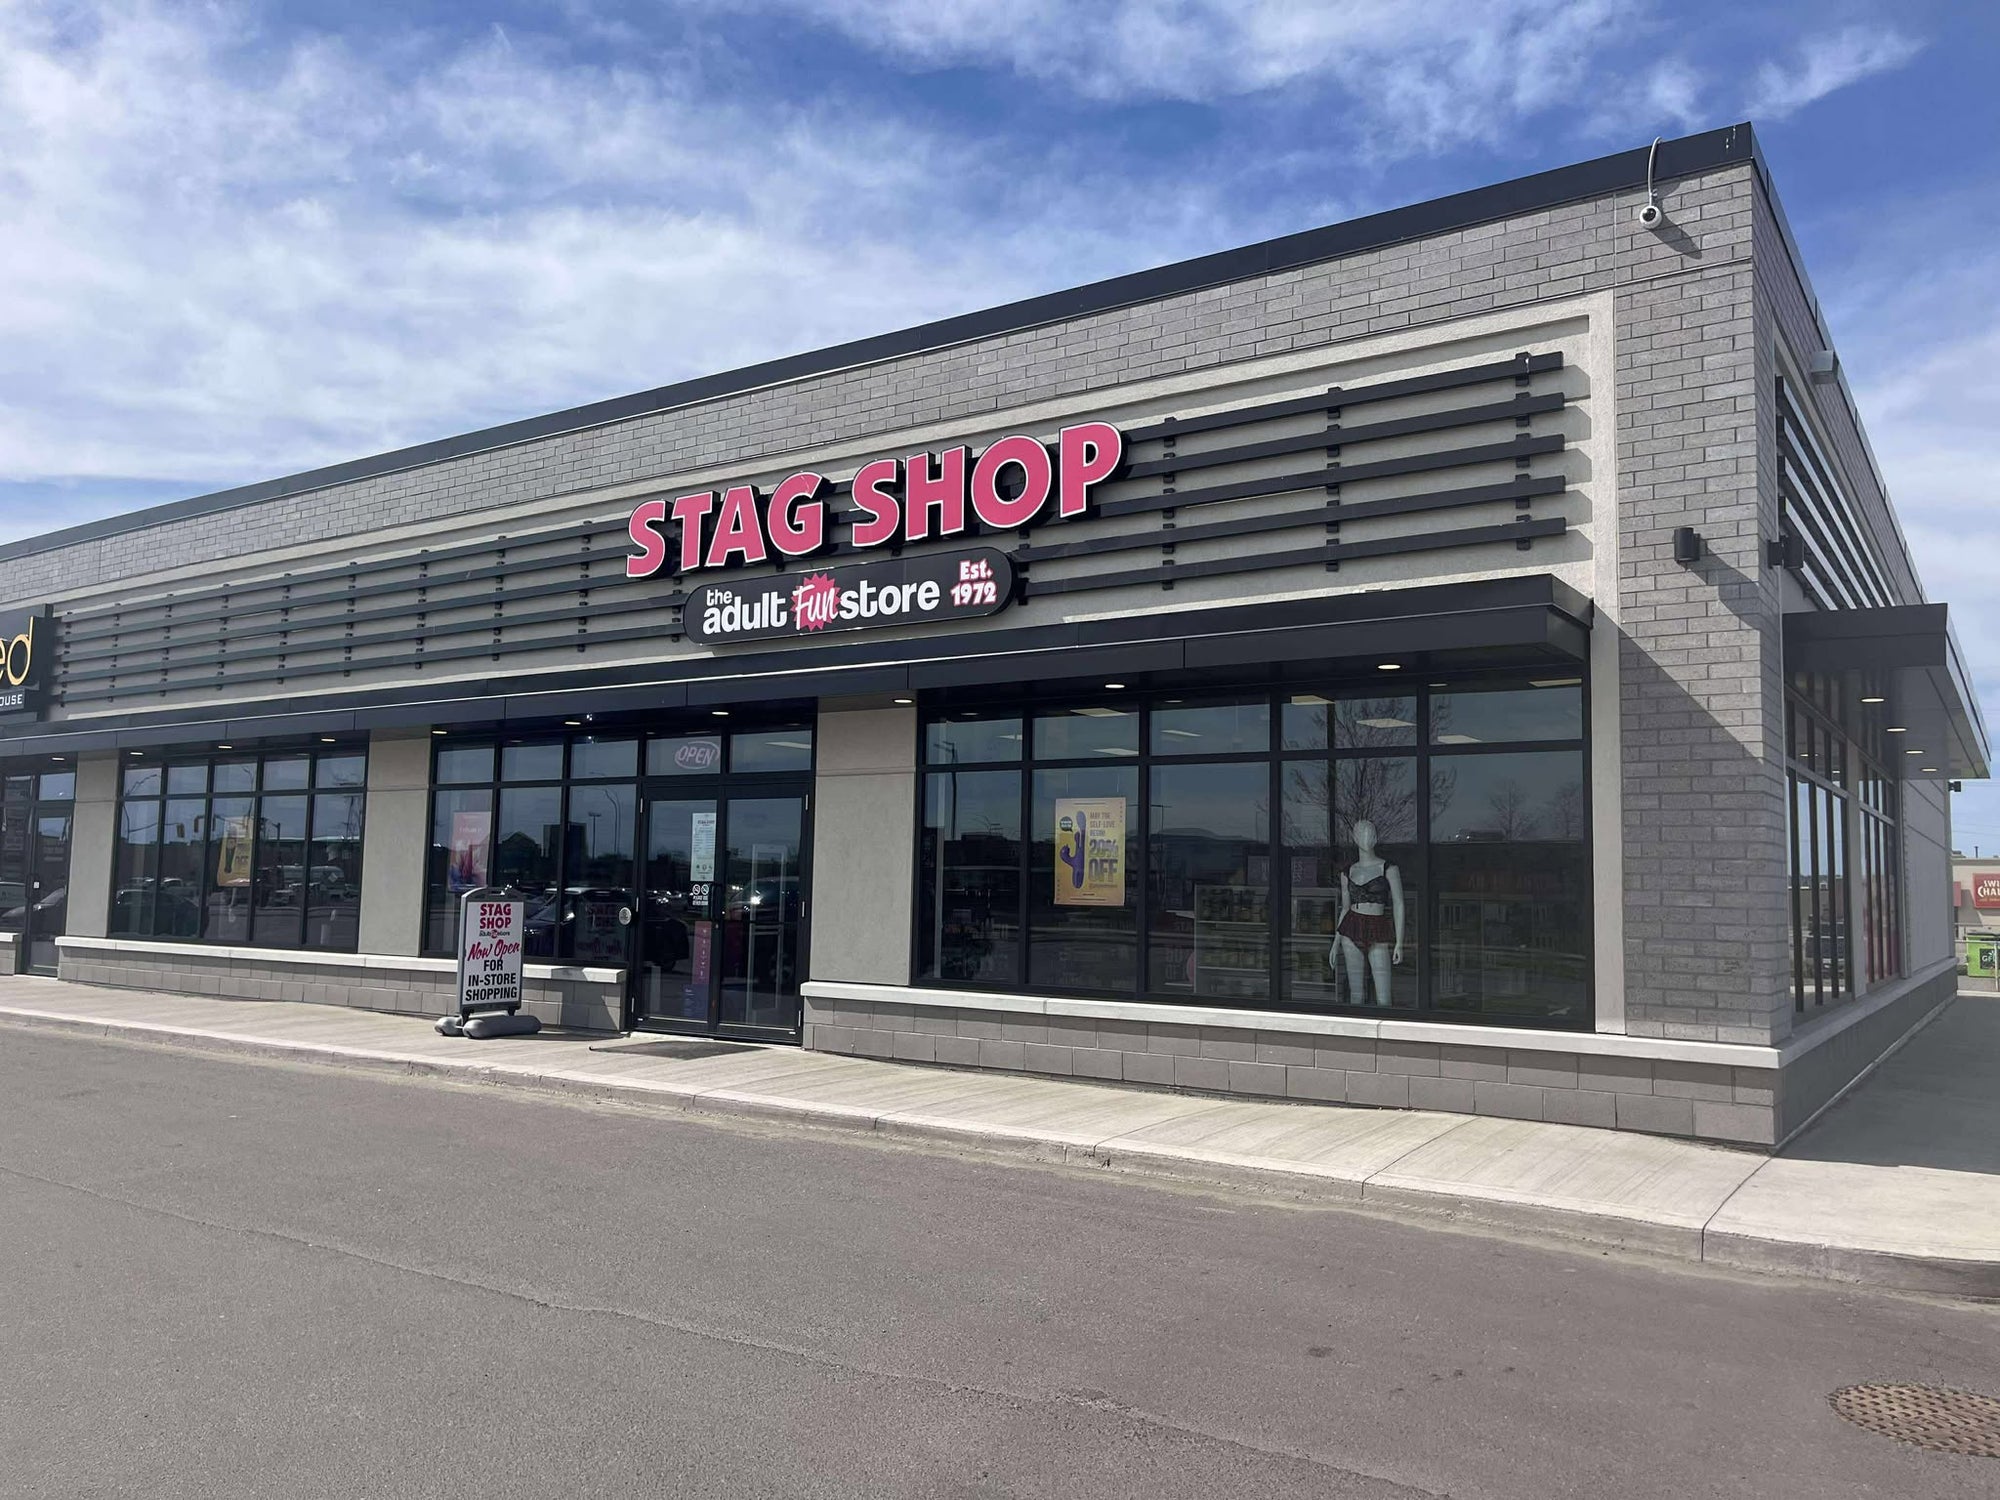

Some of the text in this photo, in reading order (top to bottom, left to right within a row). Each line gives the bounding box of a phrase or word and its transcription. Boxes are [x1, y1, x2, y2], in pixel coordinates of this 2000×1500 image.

[626, 421, 1123, 578] STAG SHOP
[959, 559, 993, 581] Est.
[706, 589, 733, 605] the
[950, 581, 998, 606] 1972
[702, 578, 941, 635] adult Fun store
[0, 616, 34, 686] d
[678, 745, 716, 767] OPEN
[1089, 859, 1119, 882] OFF
[480, 904, 512, 916] STAG
[480, 917, 512, 929] SHOP
[467, 939, 520, 962] Now Open
[483, 960, 504, 972] FOR
[468, 973, 517, 987] IN-STORE
[465, 987, 518, 1001] SHOPPING
